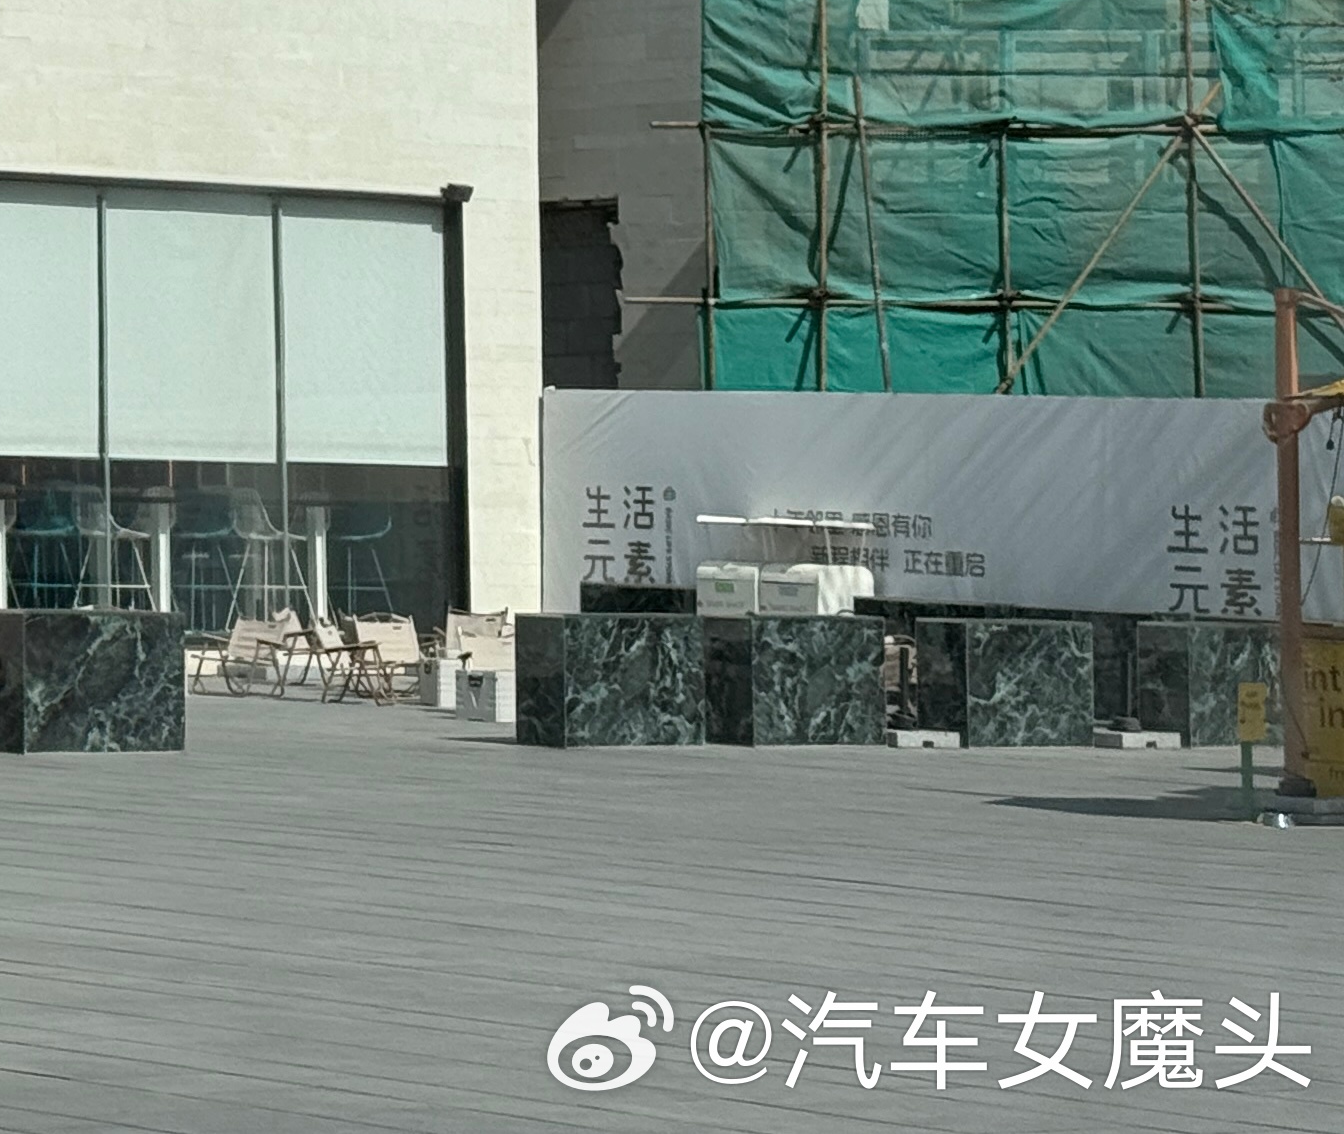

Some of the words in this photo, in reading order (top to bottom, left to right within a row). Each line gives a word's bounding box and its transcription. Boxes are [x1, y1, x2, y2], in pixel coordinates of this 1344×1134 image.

[582, 486, 655, 531] 生活
[1167, 504, 1260, 554] 生活
[583, 539, 655, 584] 元素
[904, 550, 985, 577] 正在重启
[1169, 565, 1262, 615] 元素
